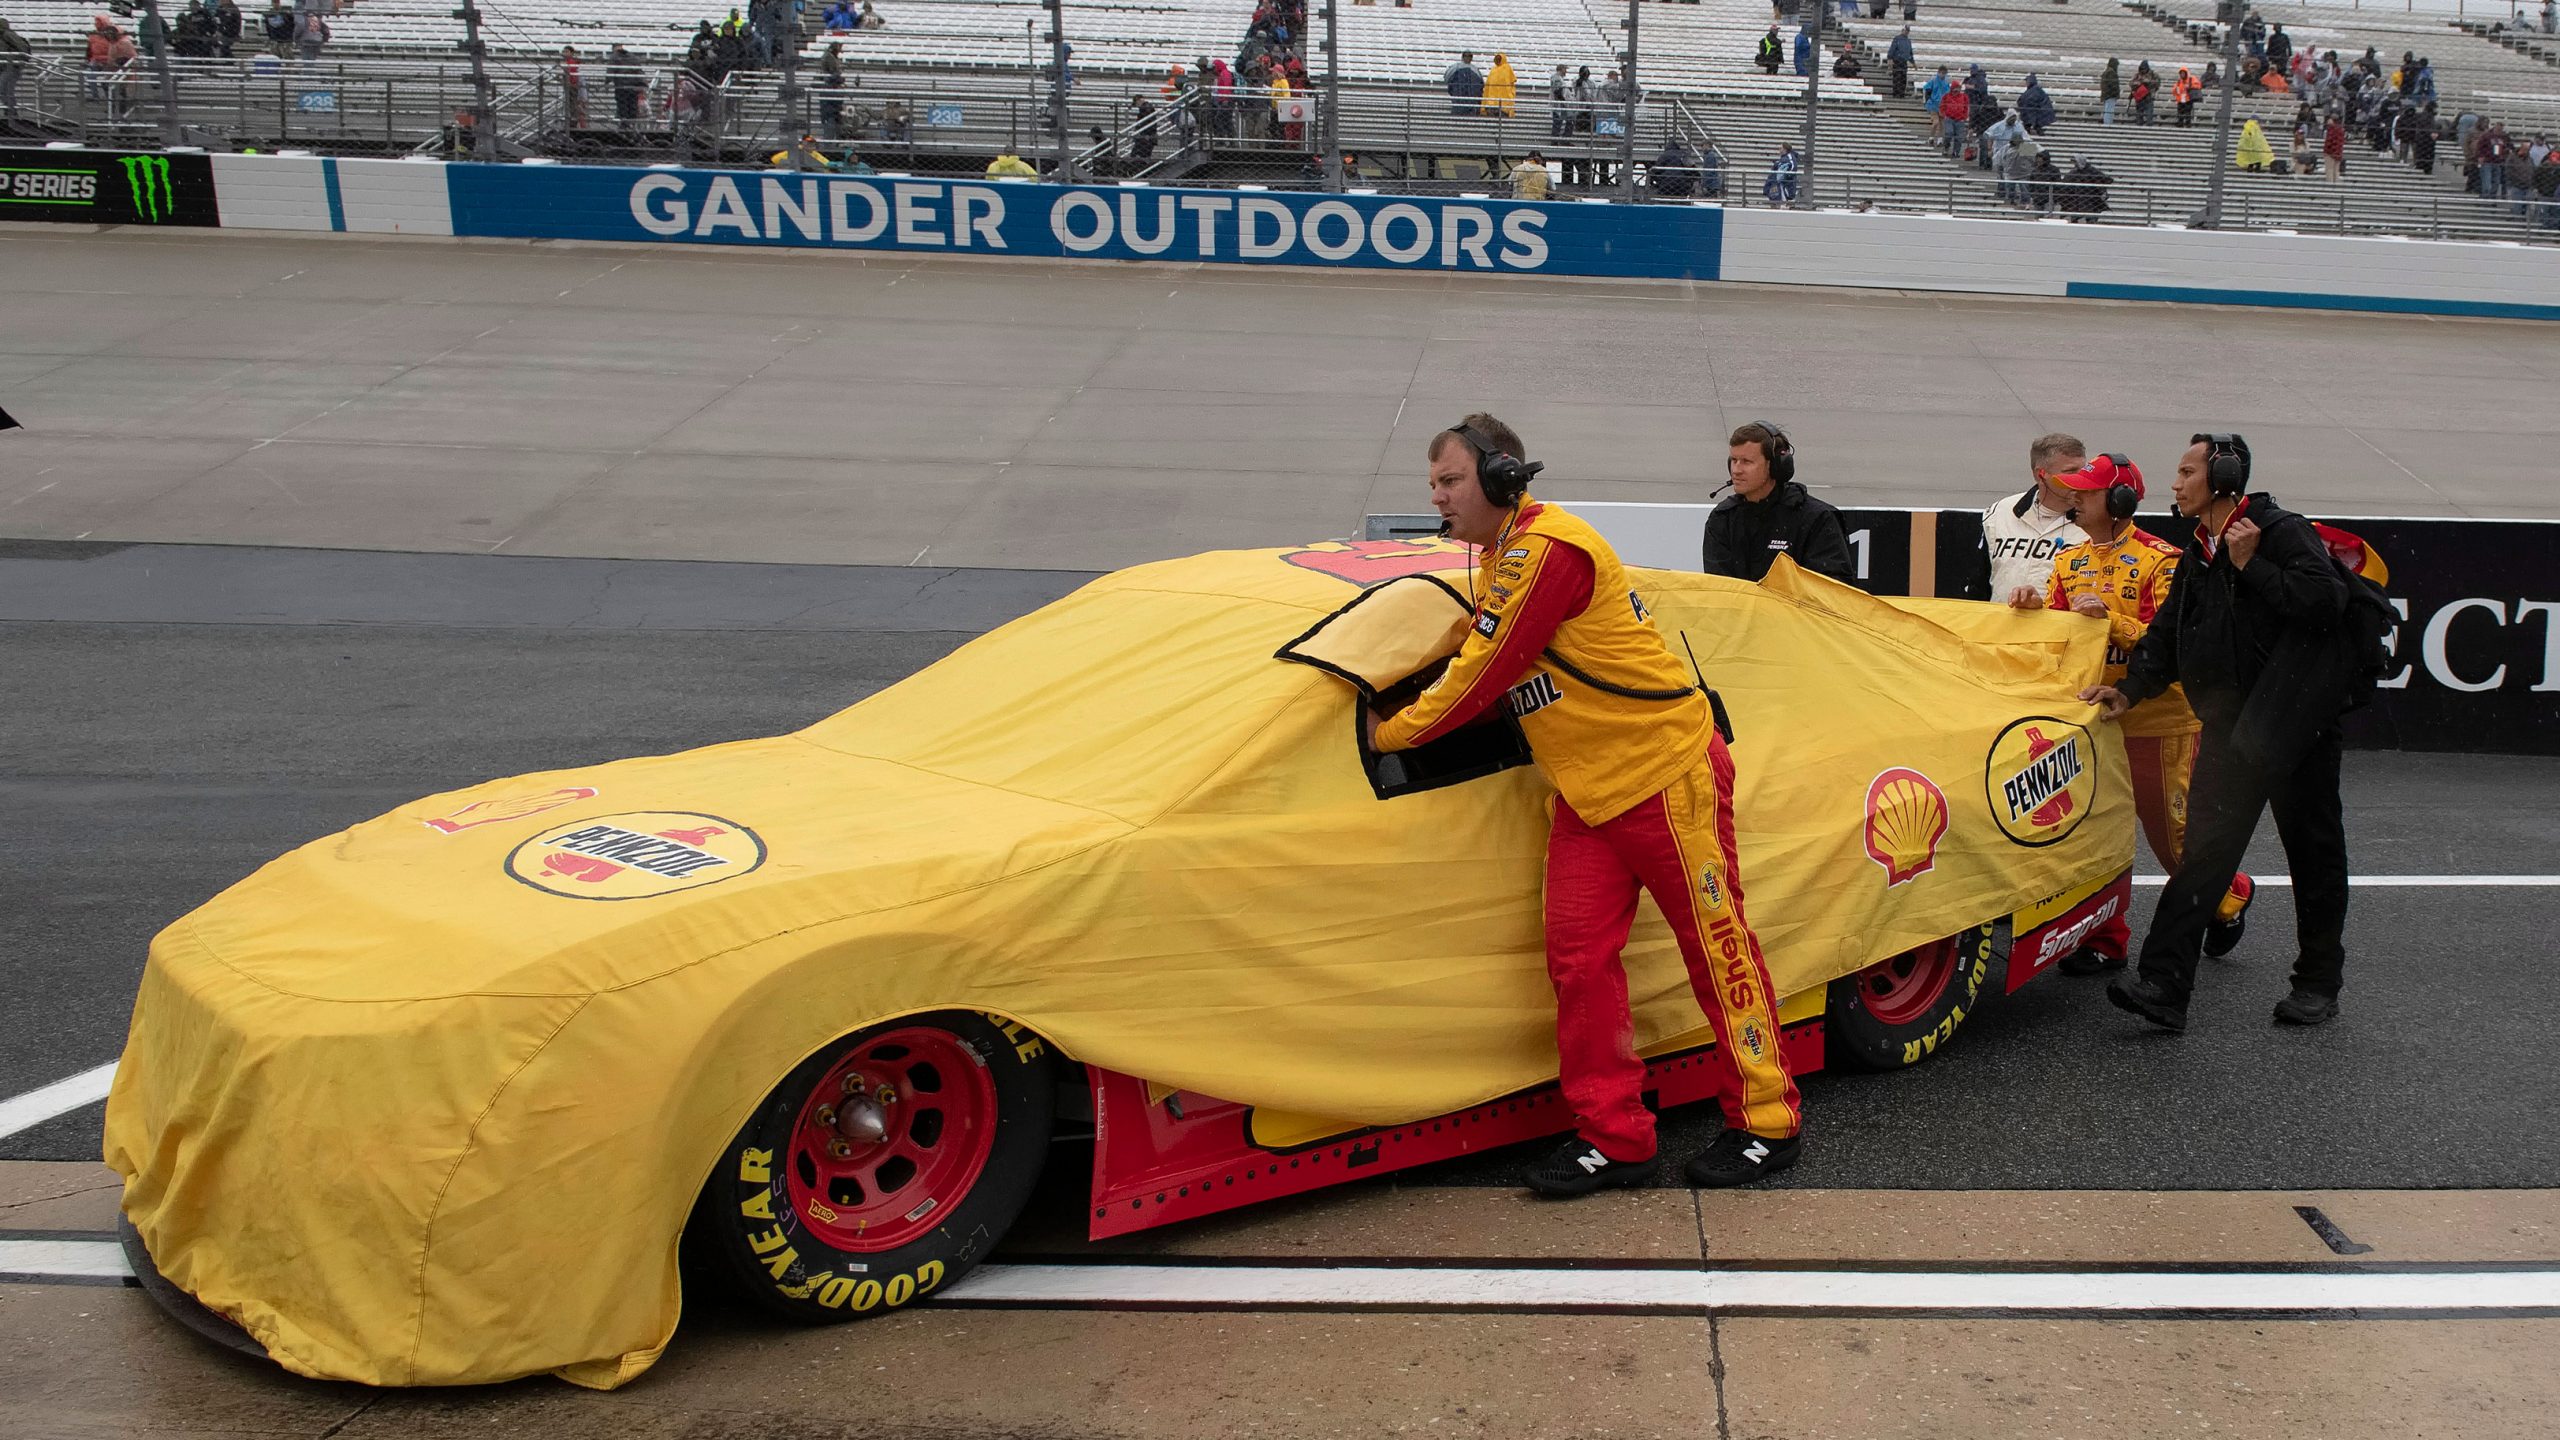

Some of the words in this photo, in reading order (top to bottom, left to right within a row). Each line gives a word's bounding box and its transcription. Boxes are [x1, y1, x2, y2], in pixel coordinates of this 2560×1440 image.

[931, 109, 962, 125] 239
[13, 174, 97, 198] SERIES
[629, 173, 1008, 249] GANDER
[1050, 190, 1549, 269] OUTDOORS
[2003, 736, 2084, 824] PENNZOIL
[539, 825, 733, 879] PENNZOIL
[1709, 915, 1754, 1010] Shell
[812, 1206, 832, 1219] AERO
